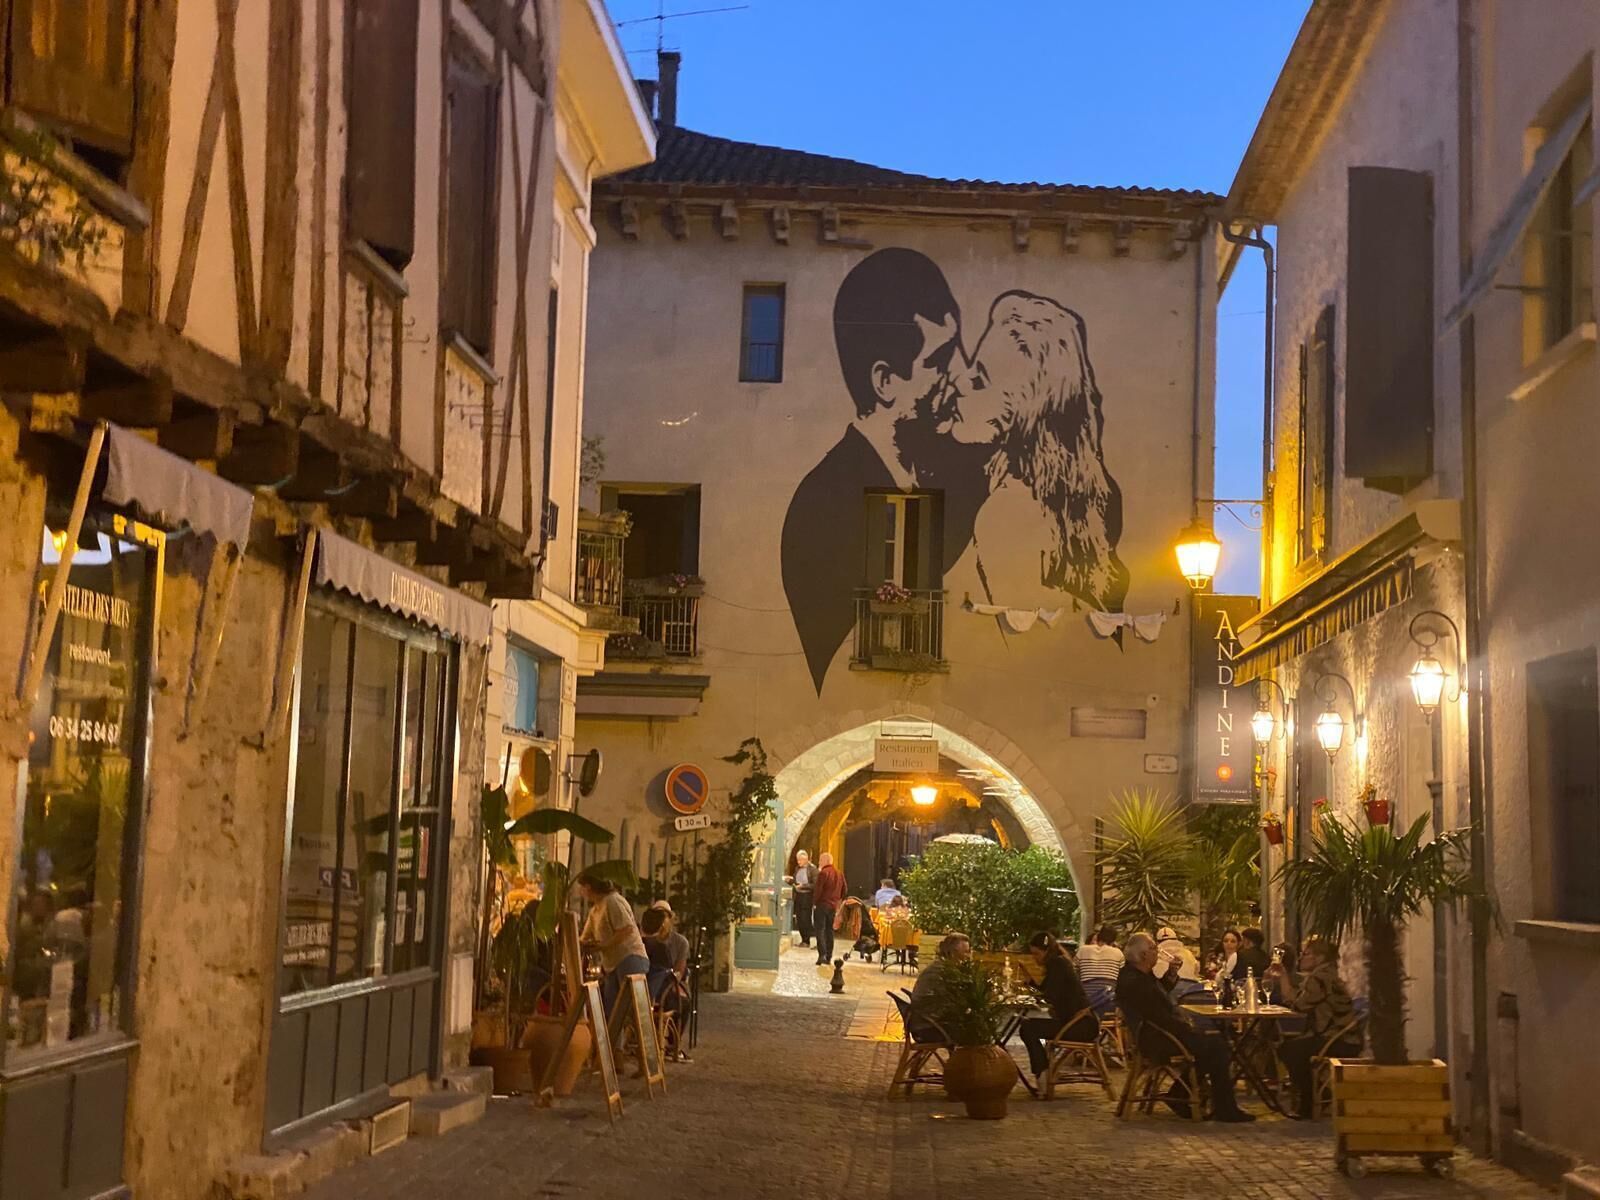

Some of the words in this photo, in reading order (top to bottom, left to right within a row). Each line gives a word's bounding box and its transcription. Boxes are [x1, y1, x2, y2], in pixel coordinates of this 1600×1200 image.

[62, 584, 94, 621] ATELIER
[95, 591, 110, 624] DES
[69, 642, 111, 666] restaurant
[1214, 610, 1237, 757] ANDINE
[49, 715, 64, 738] 06
[80, 719, 93, 741] 25
[880, 743, 932, 754] Restaurant
